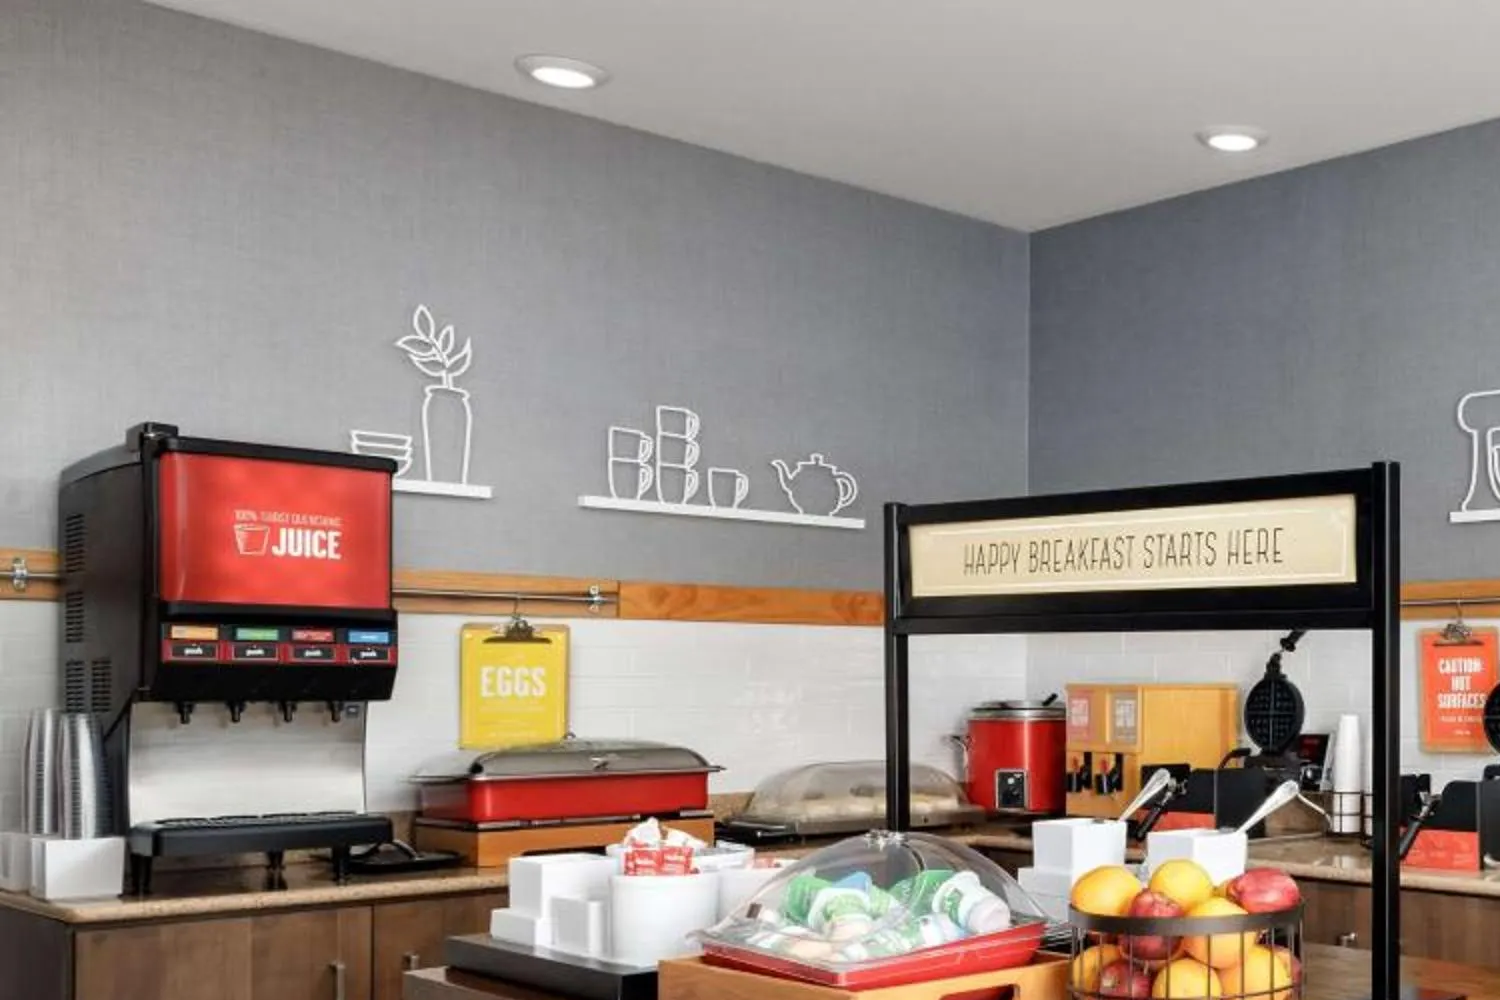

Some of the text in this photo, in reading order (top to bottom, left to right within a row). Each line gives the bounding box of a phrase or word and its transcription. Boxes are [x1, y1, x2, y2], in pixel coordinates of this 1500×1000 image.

[271, 527, 342, 559] JUICE
[963, 527, 1285, 576] HAPPY BREAKFAST STARTS HERE
[480, 665, 547, 698] EGGS
[1451, 676, 1472, 690] HOT
